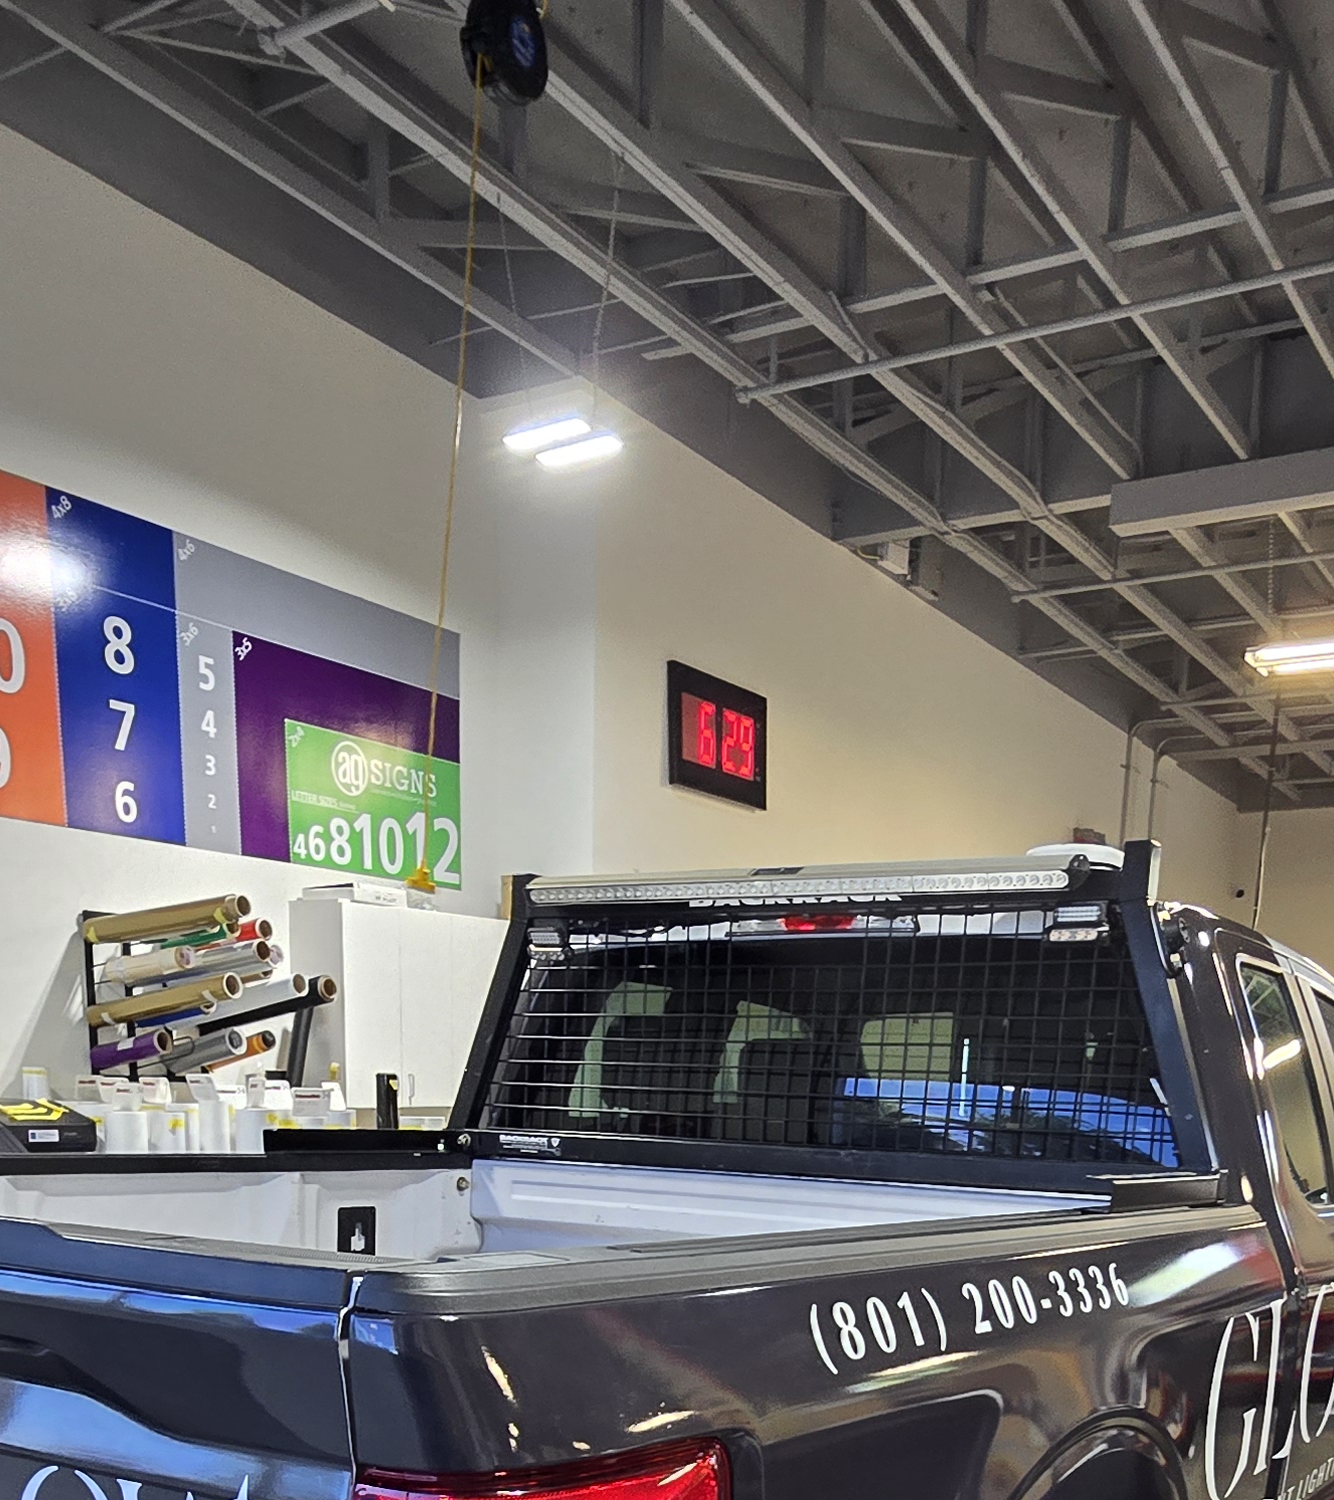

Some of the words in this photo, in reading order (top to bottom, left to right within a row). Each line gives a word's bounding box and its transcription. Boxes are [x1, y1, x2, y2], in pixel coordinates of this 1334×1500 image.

[51, 496, 72, 519] 4x8
[177, 539, 196, 561] 4x6
[103, 616, 135, 675] 8
[180, 622, 199, 646] 3x6
[234, 637, 253, 661] 3x5
[198, 655, 216, 691] 5
[109, 699, 136, 751] 7
[201, 710, 217, 738] 4
[204, 755, 217, 777] 3
[370, 759, 437, 797] SIGNS
[115, 781, 138, 823] 6
[207, 794, 217, 809] 2
[810, 1288, 947, 1375] (801)
[961, 1262, 1130, 1334] 200-3336
